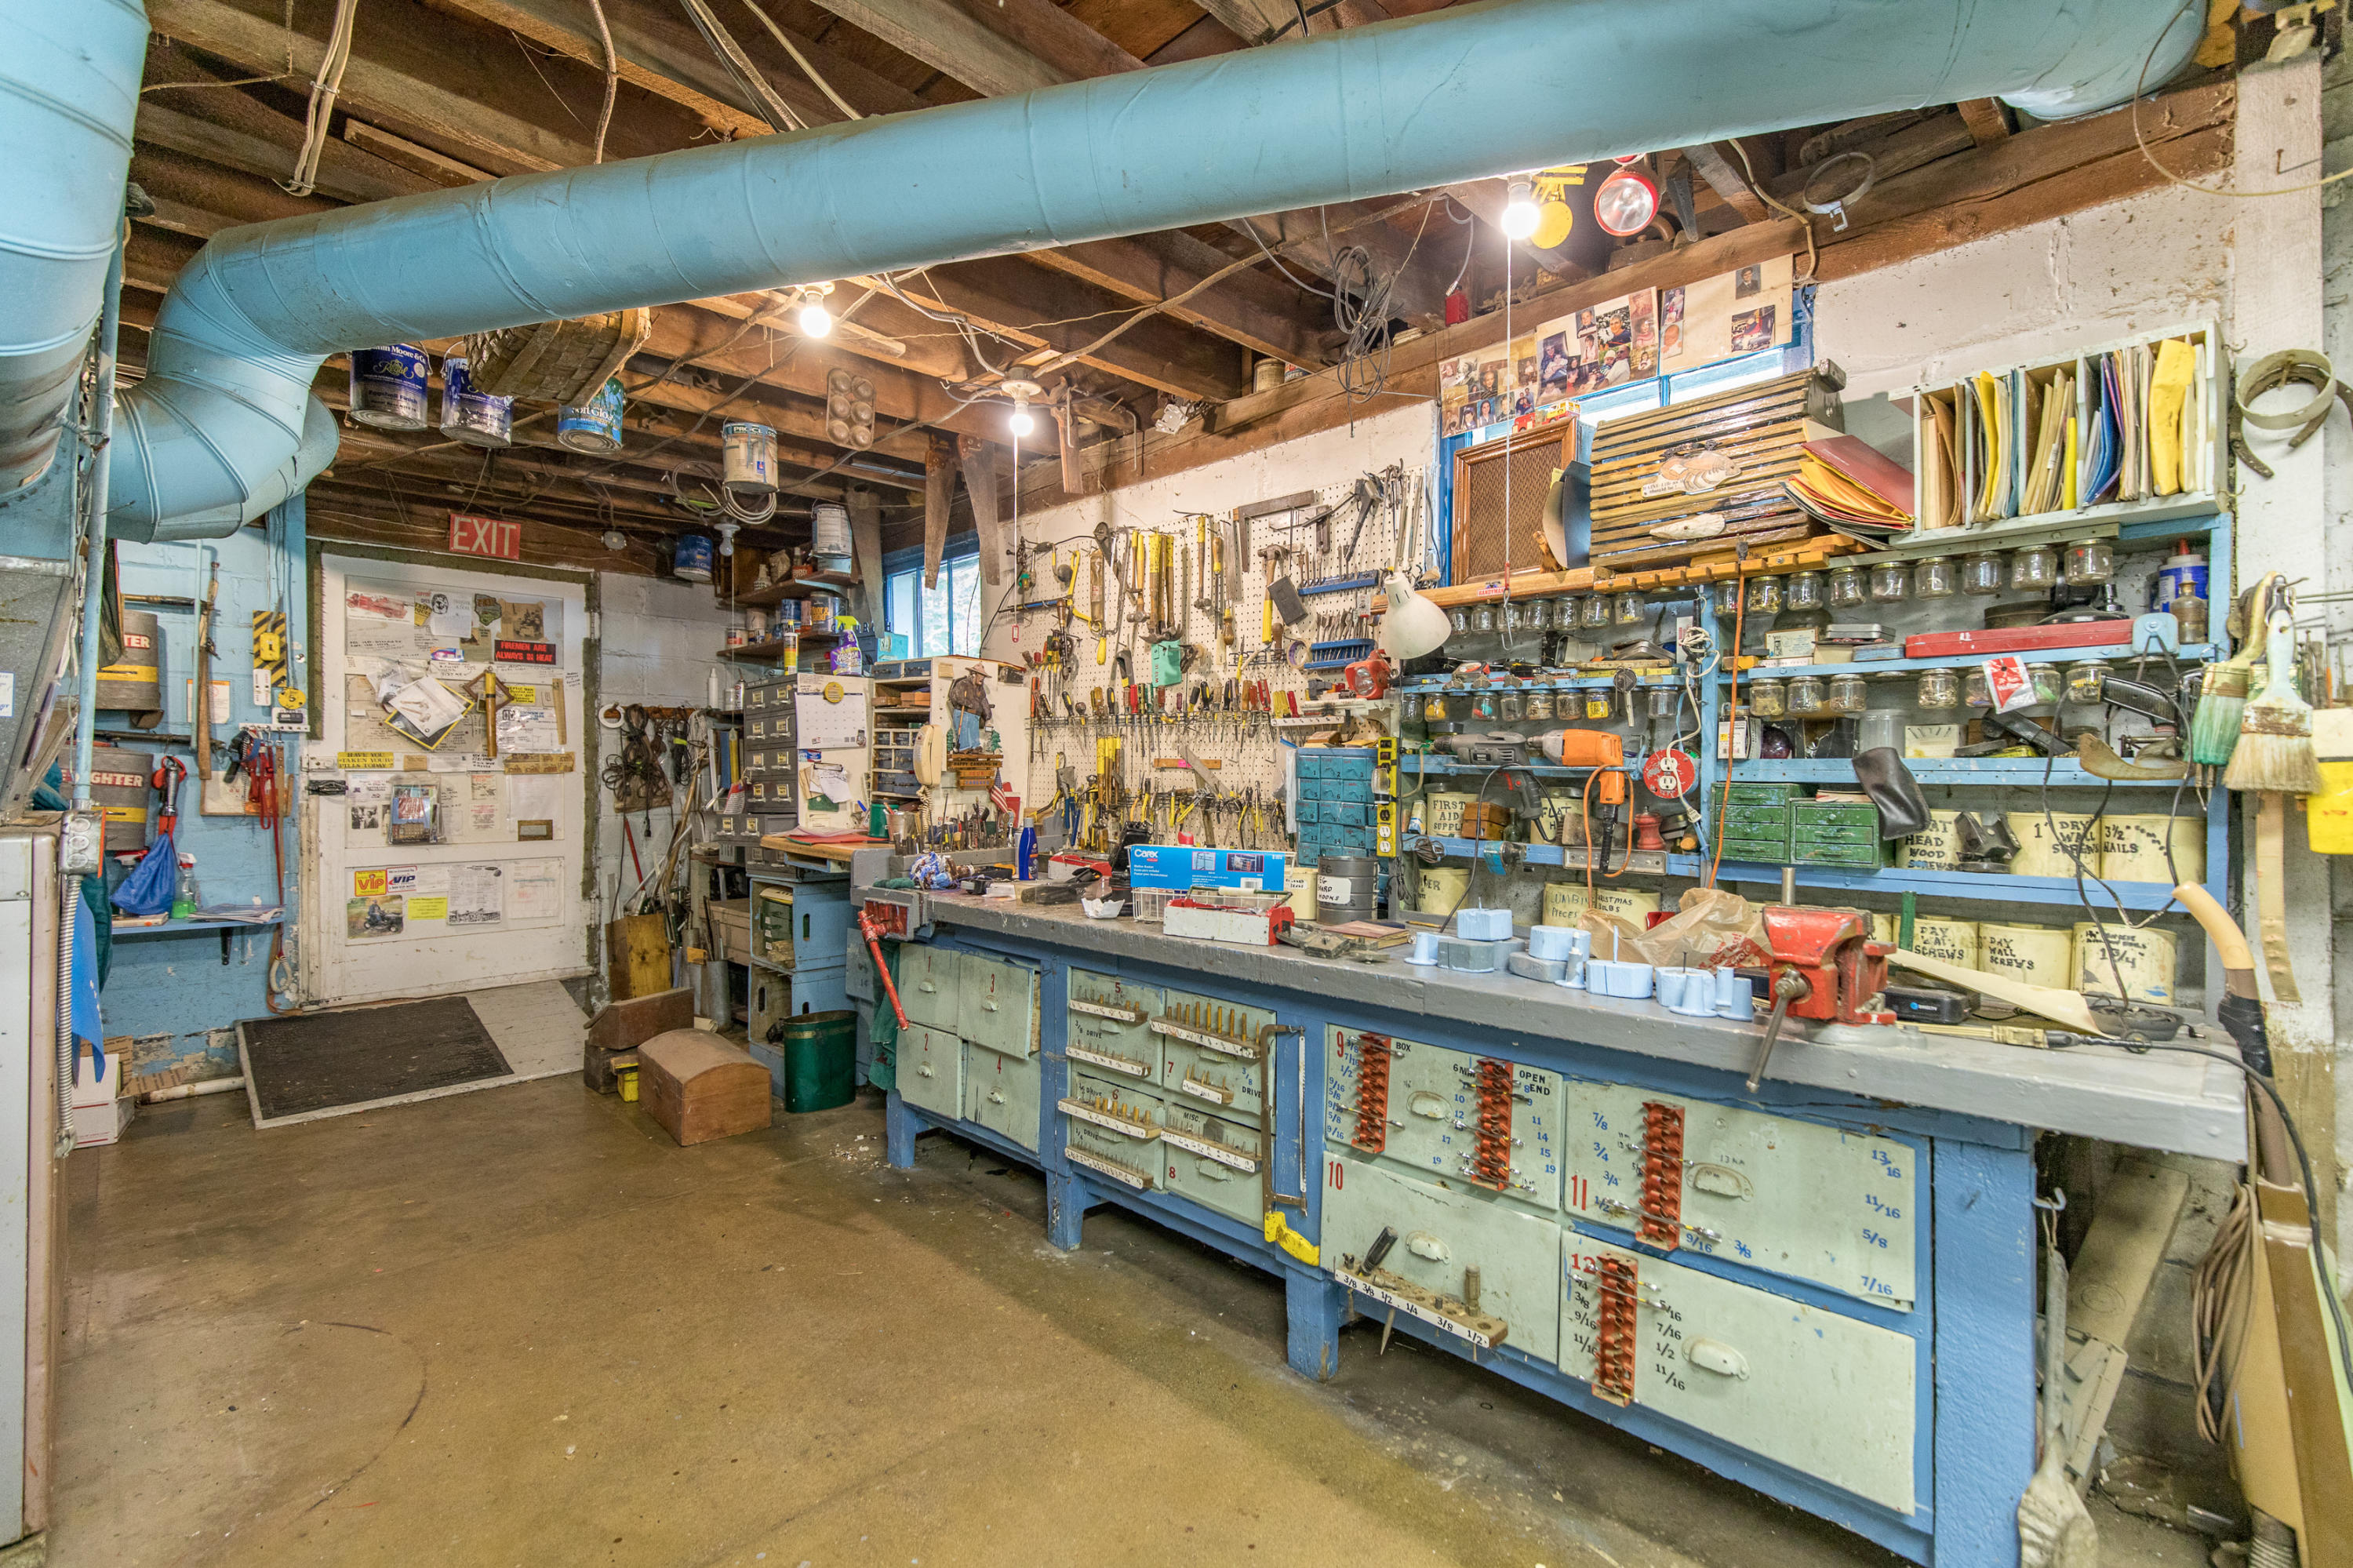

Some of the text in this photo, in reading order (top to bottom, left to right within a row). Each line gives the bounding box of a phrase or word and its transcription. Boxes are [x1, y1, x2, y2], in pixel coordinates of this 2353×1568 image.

[391, 346, 414, 358] Moore
[453, 516, 517, 556] EXIT
[1478, 587, 1504, 596] HANDYMAN
[500, 642, 530, 651] FIREMEN
[496, 652, 523, 660] ALWAYS
[536, 653, 553, 662] HEAT
[837, 652, 860, 662] KABOOM
[1433, 799, 1466, 810] FIRST
[1439, 812, 1460, 821] AID
[1433, 822, 1461, 831] SUPPL
[1929, 820, 1952, 833] AT
[1905, 835, 1944, 846] HEAD
[1134, 849, 1158, 858] Carex
[1909, 847, 1945, 857] WOOD
[2104, 843, 2138, 853] NAILS
[1907, 860, 1956, 871] SEWS
[358, 874, 384, 890] VIP
[394, 875, 416, 884] VIP
[1551, 908, 1577, 919] PIECES
[1921, 926, 1949, 937] DRY
[1990, 936, 2013, 949] DRY
[1915, 944, 1965, 959] SCREWS
[1989, 947, 2017, 957] WALL
[927, 955, 932, 973] 1
[1990, 957, 2035, 970] SCREWS
[990, 973, 995, 993] 3
[1115, 982, 1121, 993] 5
[1086, 1029, 1102, 1039] DRIVE
[924, 1032, 929, 1052] 2
[1337, 1031, 1344, 1057] 9
[1347, 1039, 1358, 1053] 3/8
[1395, 1041, 1411, 1052] BOX
[997, 1055, 1002, 1075] 4
[1344, 1053, 1359, 1067] 7/16
[1168, 1061, 1174, 1074] 7
[1340, 1064, 1353, 1079] 1/2
[1242, 1067, 1253, 1086] 3/8
[1519, 1070, 1546, 1084] OPEN
[1329, 1076, 1345, 1093] 9/16
[1524, 1084, 1530, 1093] 8
[1529, 1083, 1551, 1097] END
[1112, 1089, 1118, 1100] 6
[1242, 1086, 1262, 1098] DRIVE
[1329, 1087, 1341, 1101] 5/8
[1454, 1093, 1465, 1104] 10
[1183, 1111, 1201, 1123] MISC.
[1329, 1111, 1341, 1124] 5/8
[1454, 1110, 1464, 1119] 12
[1532, 1116, 1541, 1126] 11
[1592, 1111, 1608, 1130] 7/8
[1083, 1128, 1099, 1141] DRIVE
[1327, 1124, 1344, 1140] 9/16
[1537, 1132, 1549, 1142] 14
[1442, 1134, 1451, 1144] 17
[1540, 1148, 1551, 1158] 15
[1594, 1142, 1609, 1162] 3/4
[1432, 1155, 1442, 1165] 19
[1169, 1166, 1176, 1179] 8
[1545, 1164, 1556, 1173] 19
[1329, 1160, 1344, 1191] 10
[1603, 1170, 1619, 1187] 3/4
[1571, 1174, 1587, 1211] 11
[1595, 1195, 1610, 1213] 1/2
[1865, 1195, 1901, 1219] 11/16
[1686, 1234, 1713, 1253] 9/16
[1862, 1228, 1888, 1249] 5/8
[1734, 1240, 1751, 1258] 3/8
[1571, 1253, 1596, 1275] 12
[1860, 1275, 1893, 1295] 7/16
[1574, 1291, 1590, 1309] 3/8
[1344, 1275, 1483, 1344] 3/8 3/8 1/2 1/4 3/8 1/2
[1574, 1311, 1597, 1330] 9/16
[1657, 1322, 1682, 1341] 7/16
[1656, 1342, 1675, 1360] 1/2
[1656, 1364, 1686, 1391] 11/16
